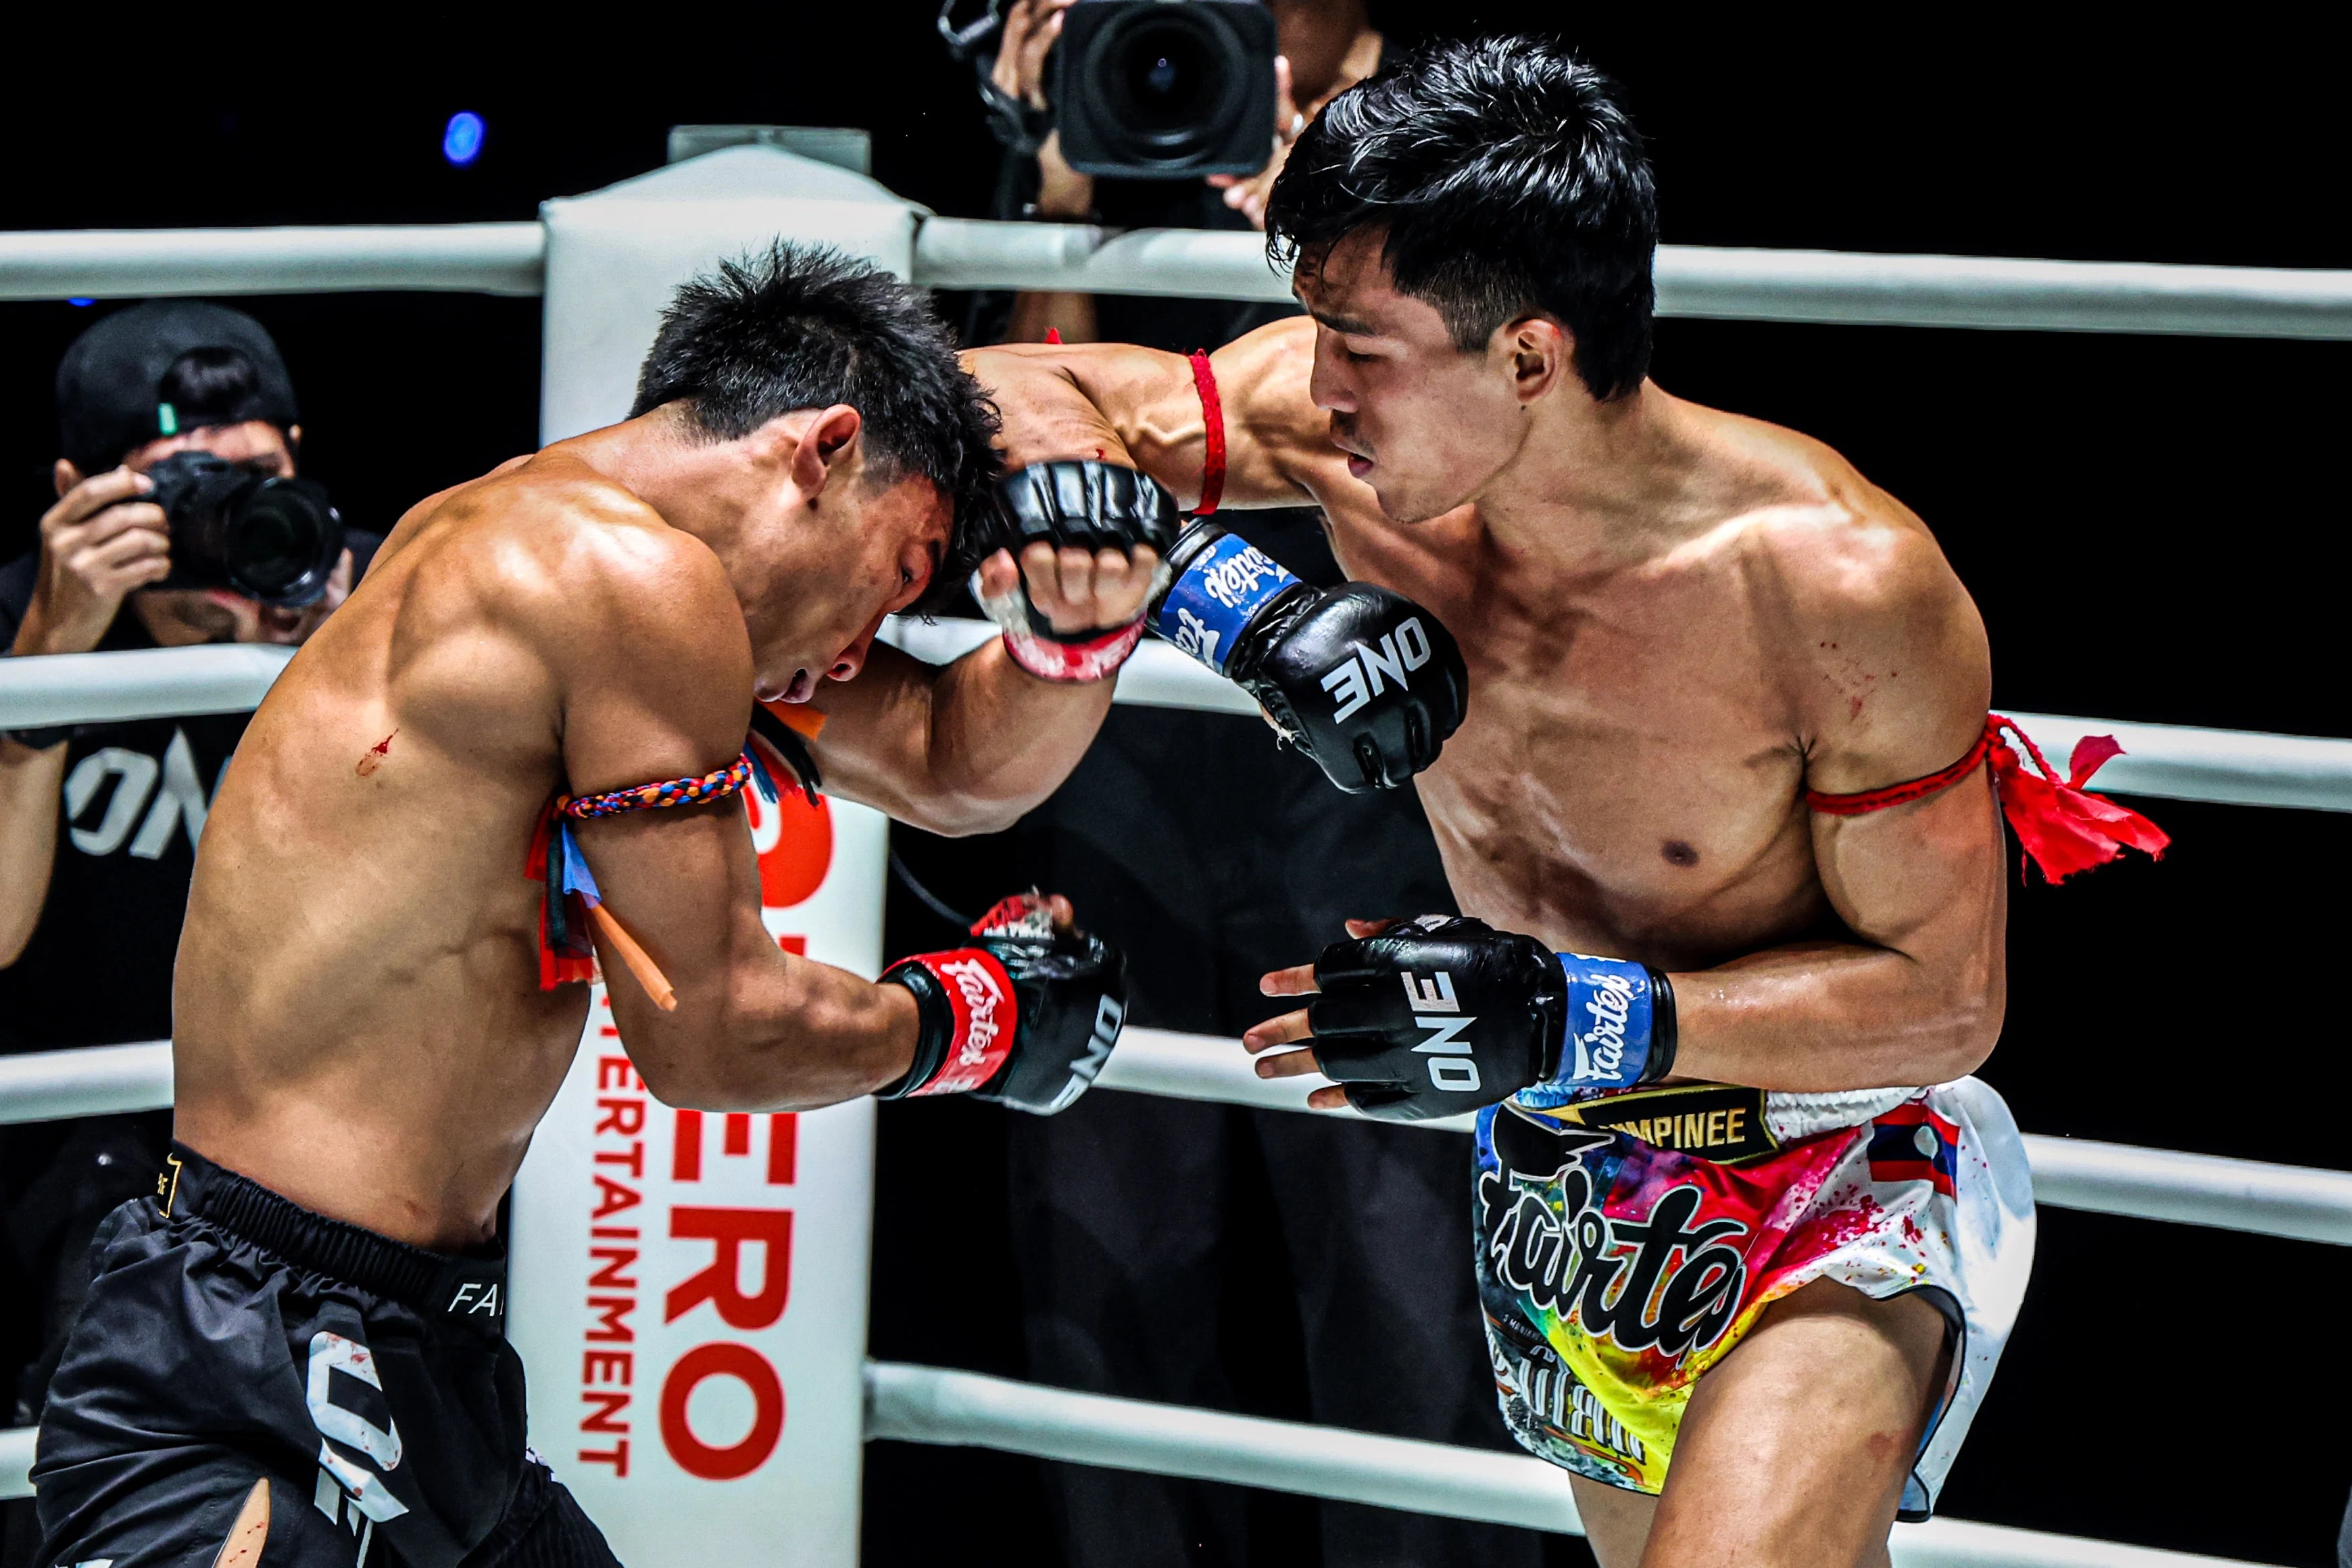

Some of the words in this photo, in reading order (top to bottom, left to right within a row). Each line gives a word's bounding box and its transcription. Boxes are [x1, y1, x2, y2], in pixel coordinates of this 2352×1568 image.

[1320, 616, 1431, 725] ONE
[940, 958, 1005, 1066] Fairtex
[1400, 971, 1481, 1092] ONE
[1573, 973, 1634, 1081] Fairtex
[1598, 1107, 1746, 1148] MPINEE
[578, 994, 650, 1479] ERTAINMENT
[659, 935, 807, 1481] ERO
[447, 1283, 503, 1317] FA
